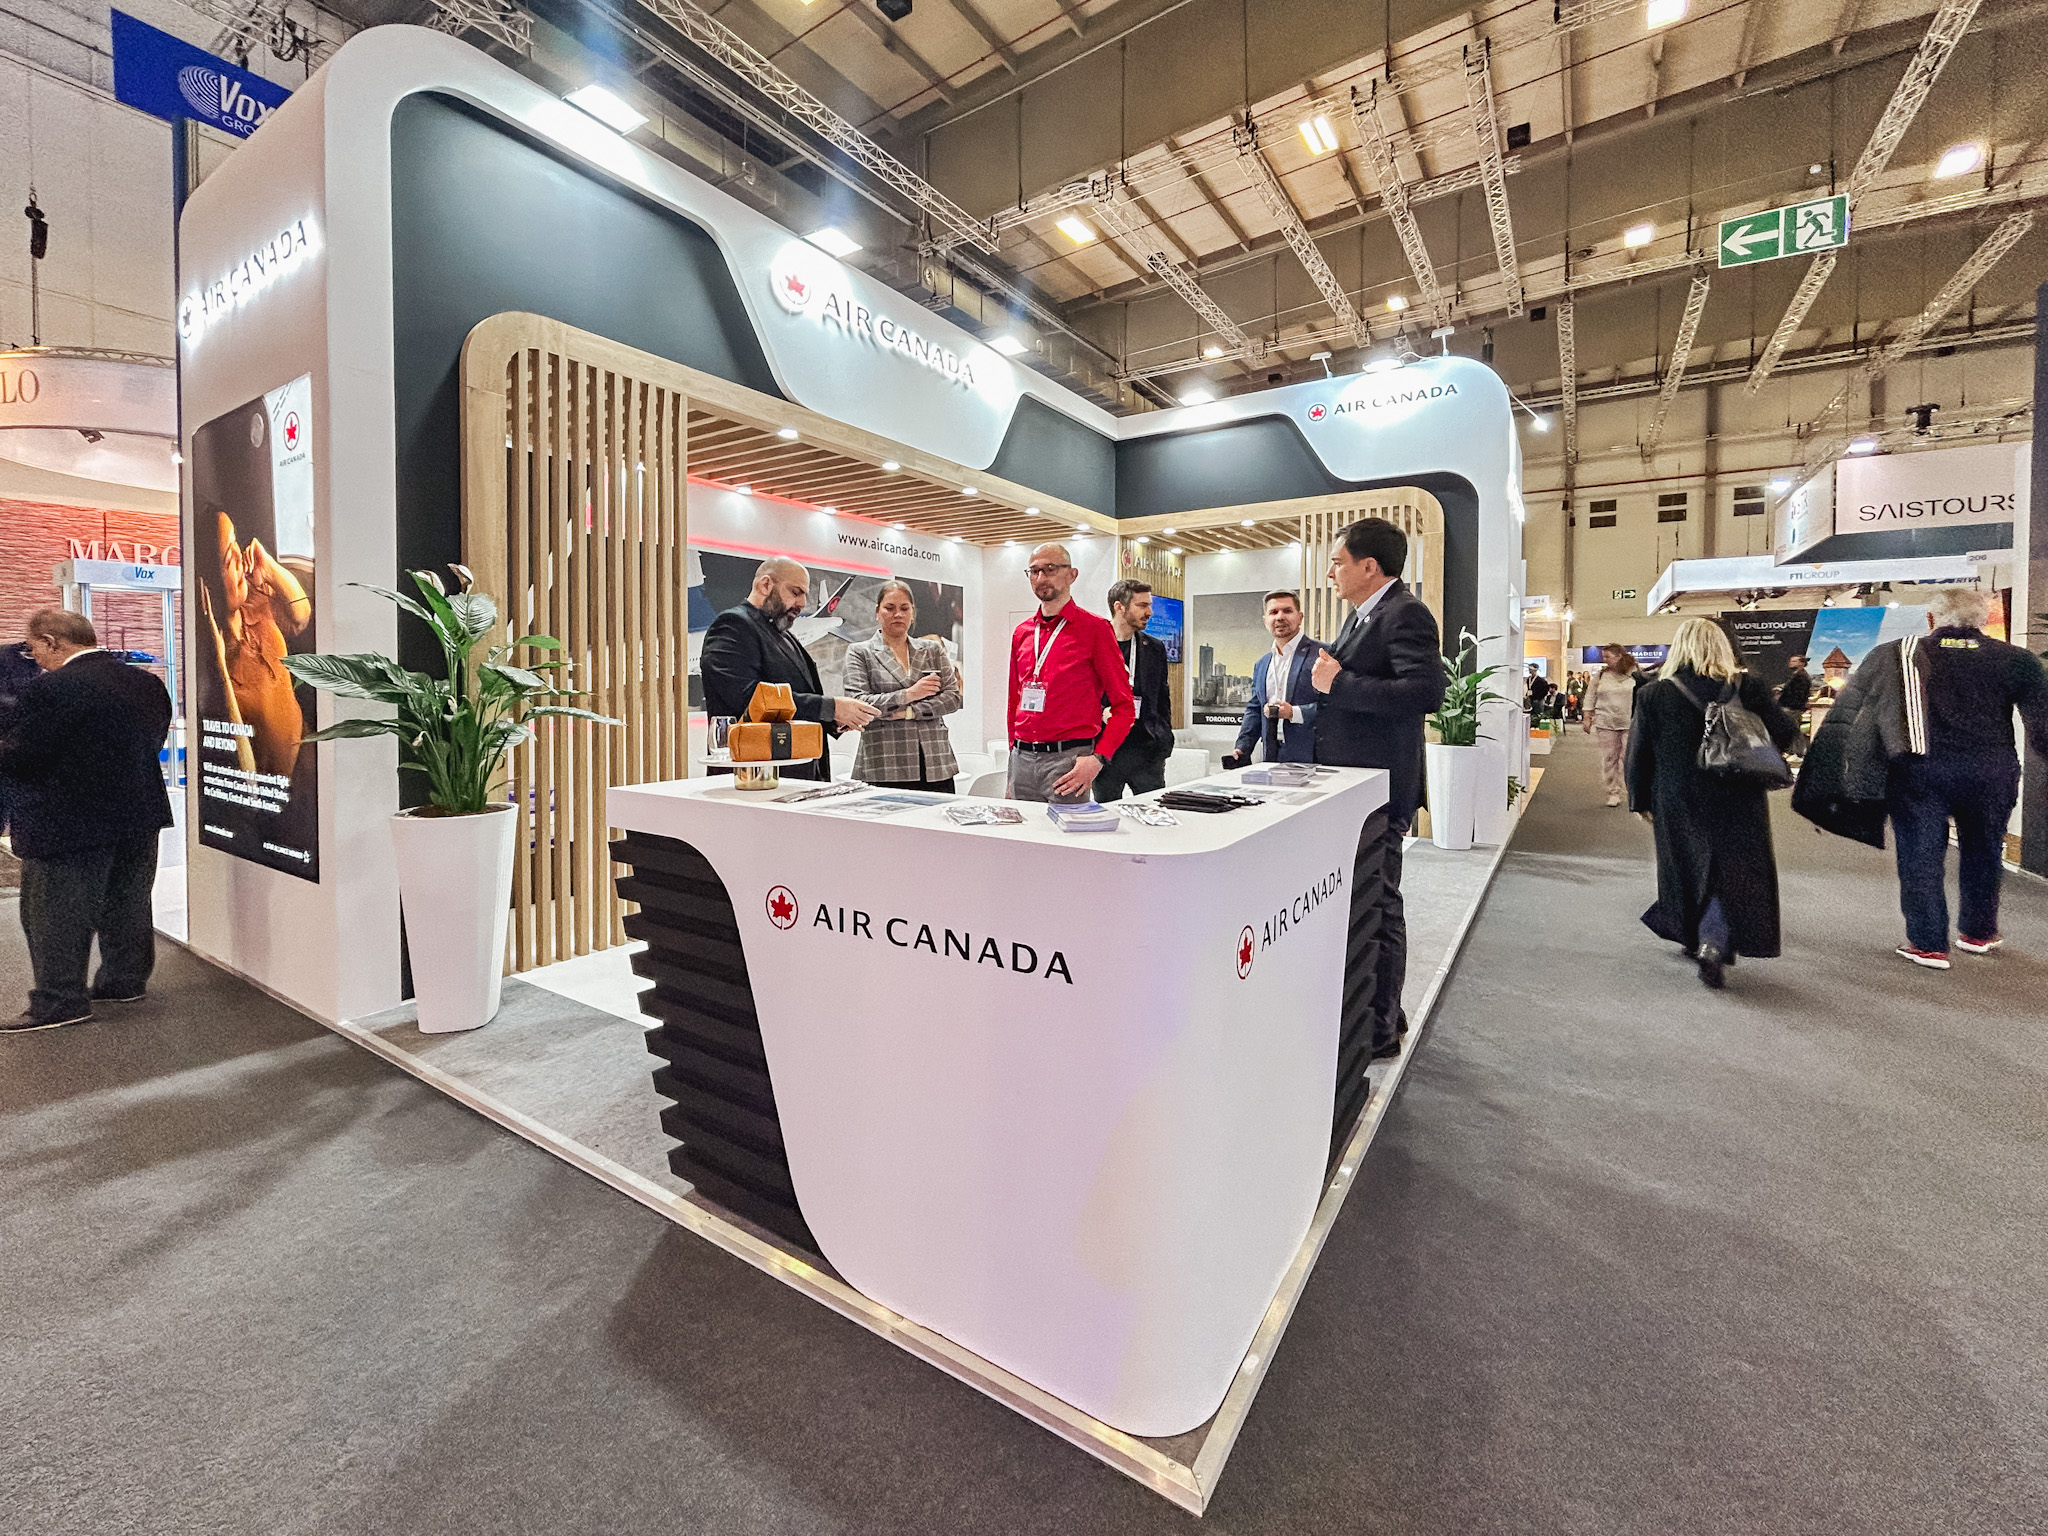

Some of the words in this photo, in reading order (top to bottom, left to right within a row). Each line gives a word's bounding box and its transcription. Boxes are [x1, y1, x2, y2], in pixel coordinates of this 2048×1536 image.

[220, 74, 277, 126] Vox
[200, 280, 226, 316] AIR
[230, 220, 308, 297] CANADA
[825, 293, 872, 333] AIR
[880, 320, 975, 384] CANADA
[1334, 400, 1366, 415] AIR
[1372, 384, 1459, 408] CANADA
[837, 533, 941, 562] www.aircanada.com
[1134, 556, 1149, 570] AIR
[134, 566, 155, 579] Vox
[1735, 621, 1807, 630] WORLDTOURIST
[1261, 908, 1288, 952] AIR
[1292, 866, 1343, 925] CANADA
[813, 903, 873, 940] AIR
[885, 917, 1074, 985] CANADA
